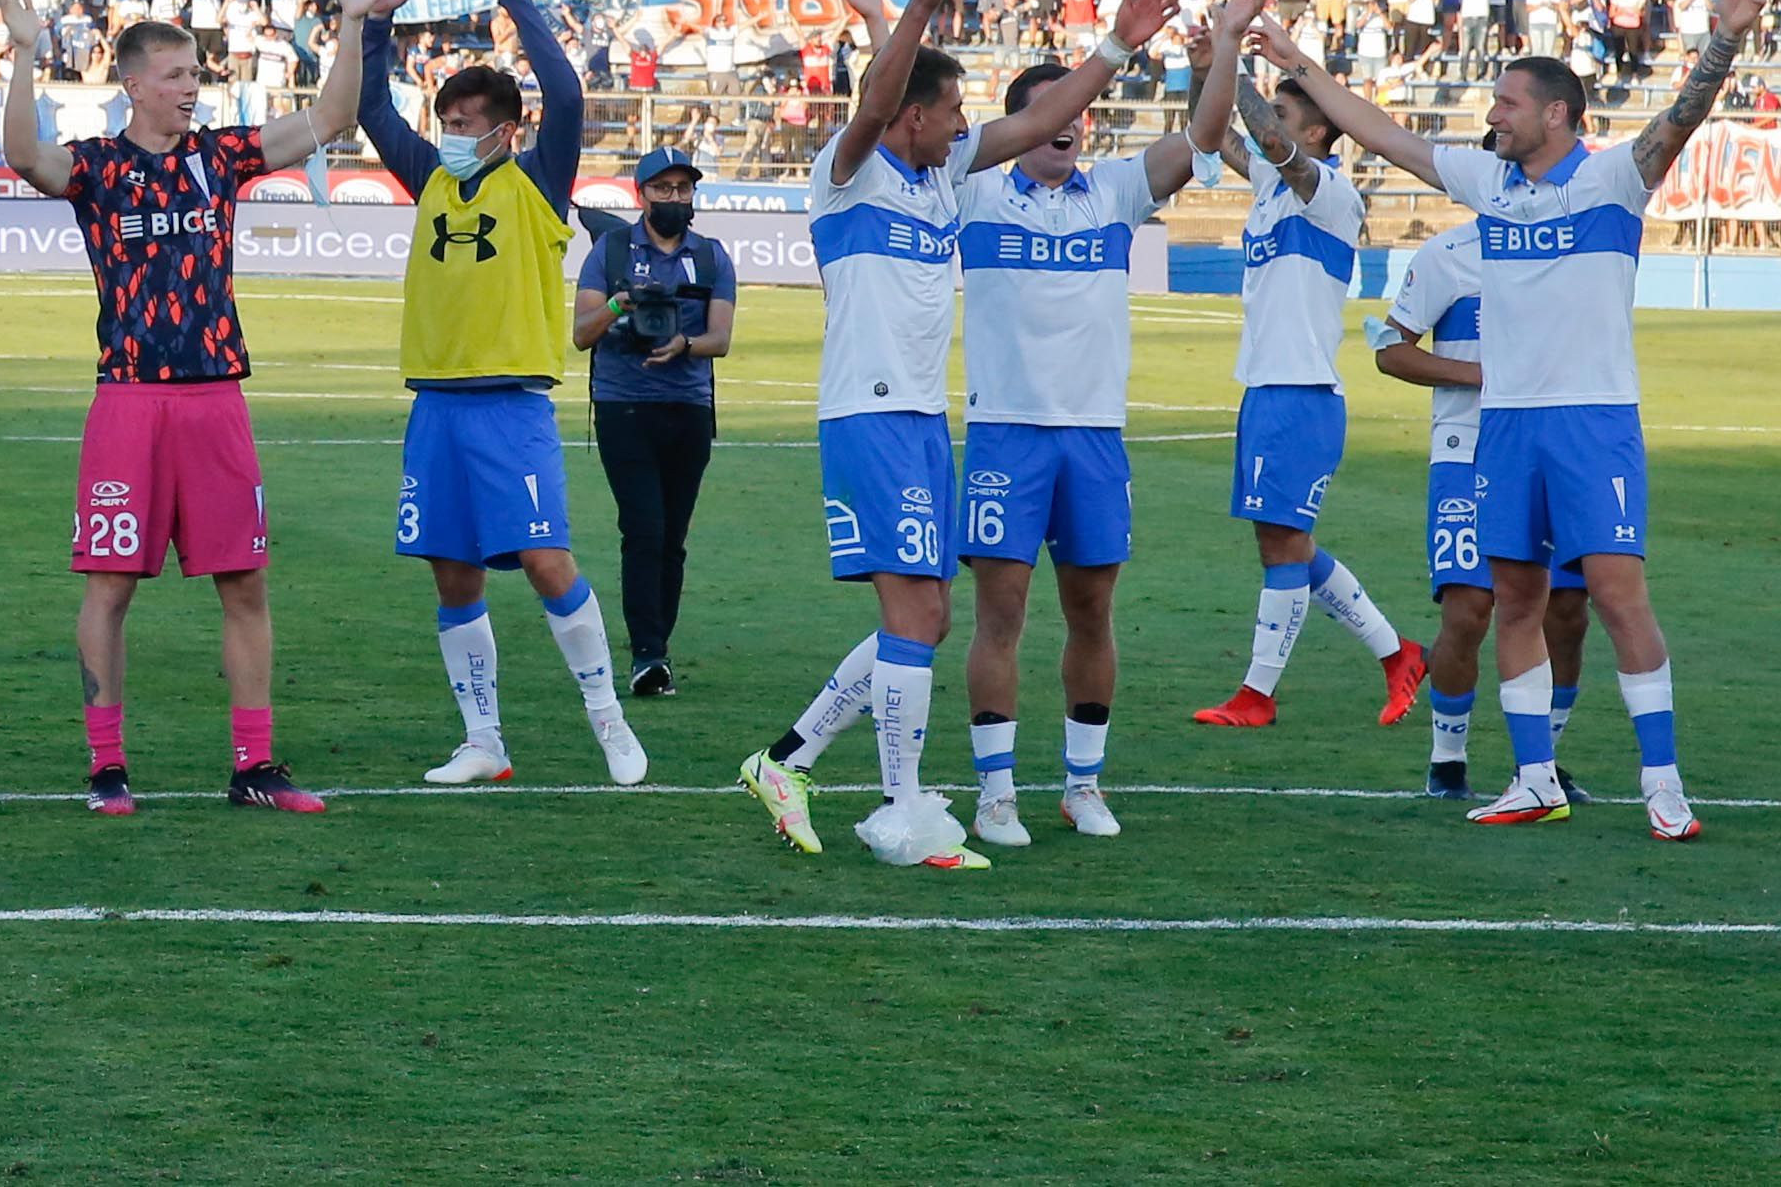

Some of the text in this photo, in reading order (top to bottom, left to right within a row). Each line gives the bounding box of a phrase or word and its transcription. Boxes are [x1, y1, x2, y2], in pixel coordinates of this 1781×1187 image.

[700, 194, 786, 212] LATAM
[152, 209, 218, 237] BICE
[1507, 225, 1575, 251] BICE
[1031, 236, 1105, 263] BICE
[89, 511, 140, 557] 28
[967, 499, 1005, 546] 16
[896, 517, 939, 566] 30
[1434, 526, 1480, 571] 26
